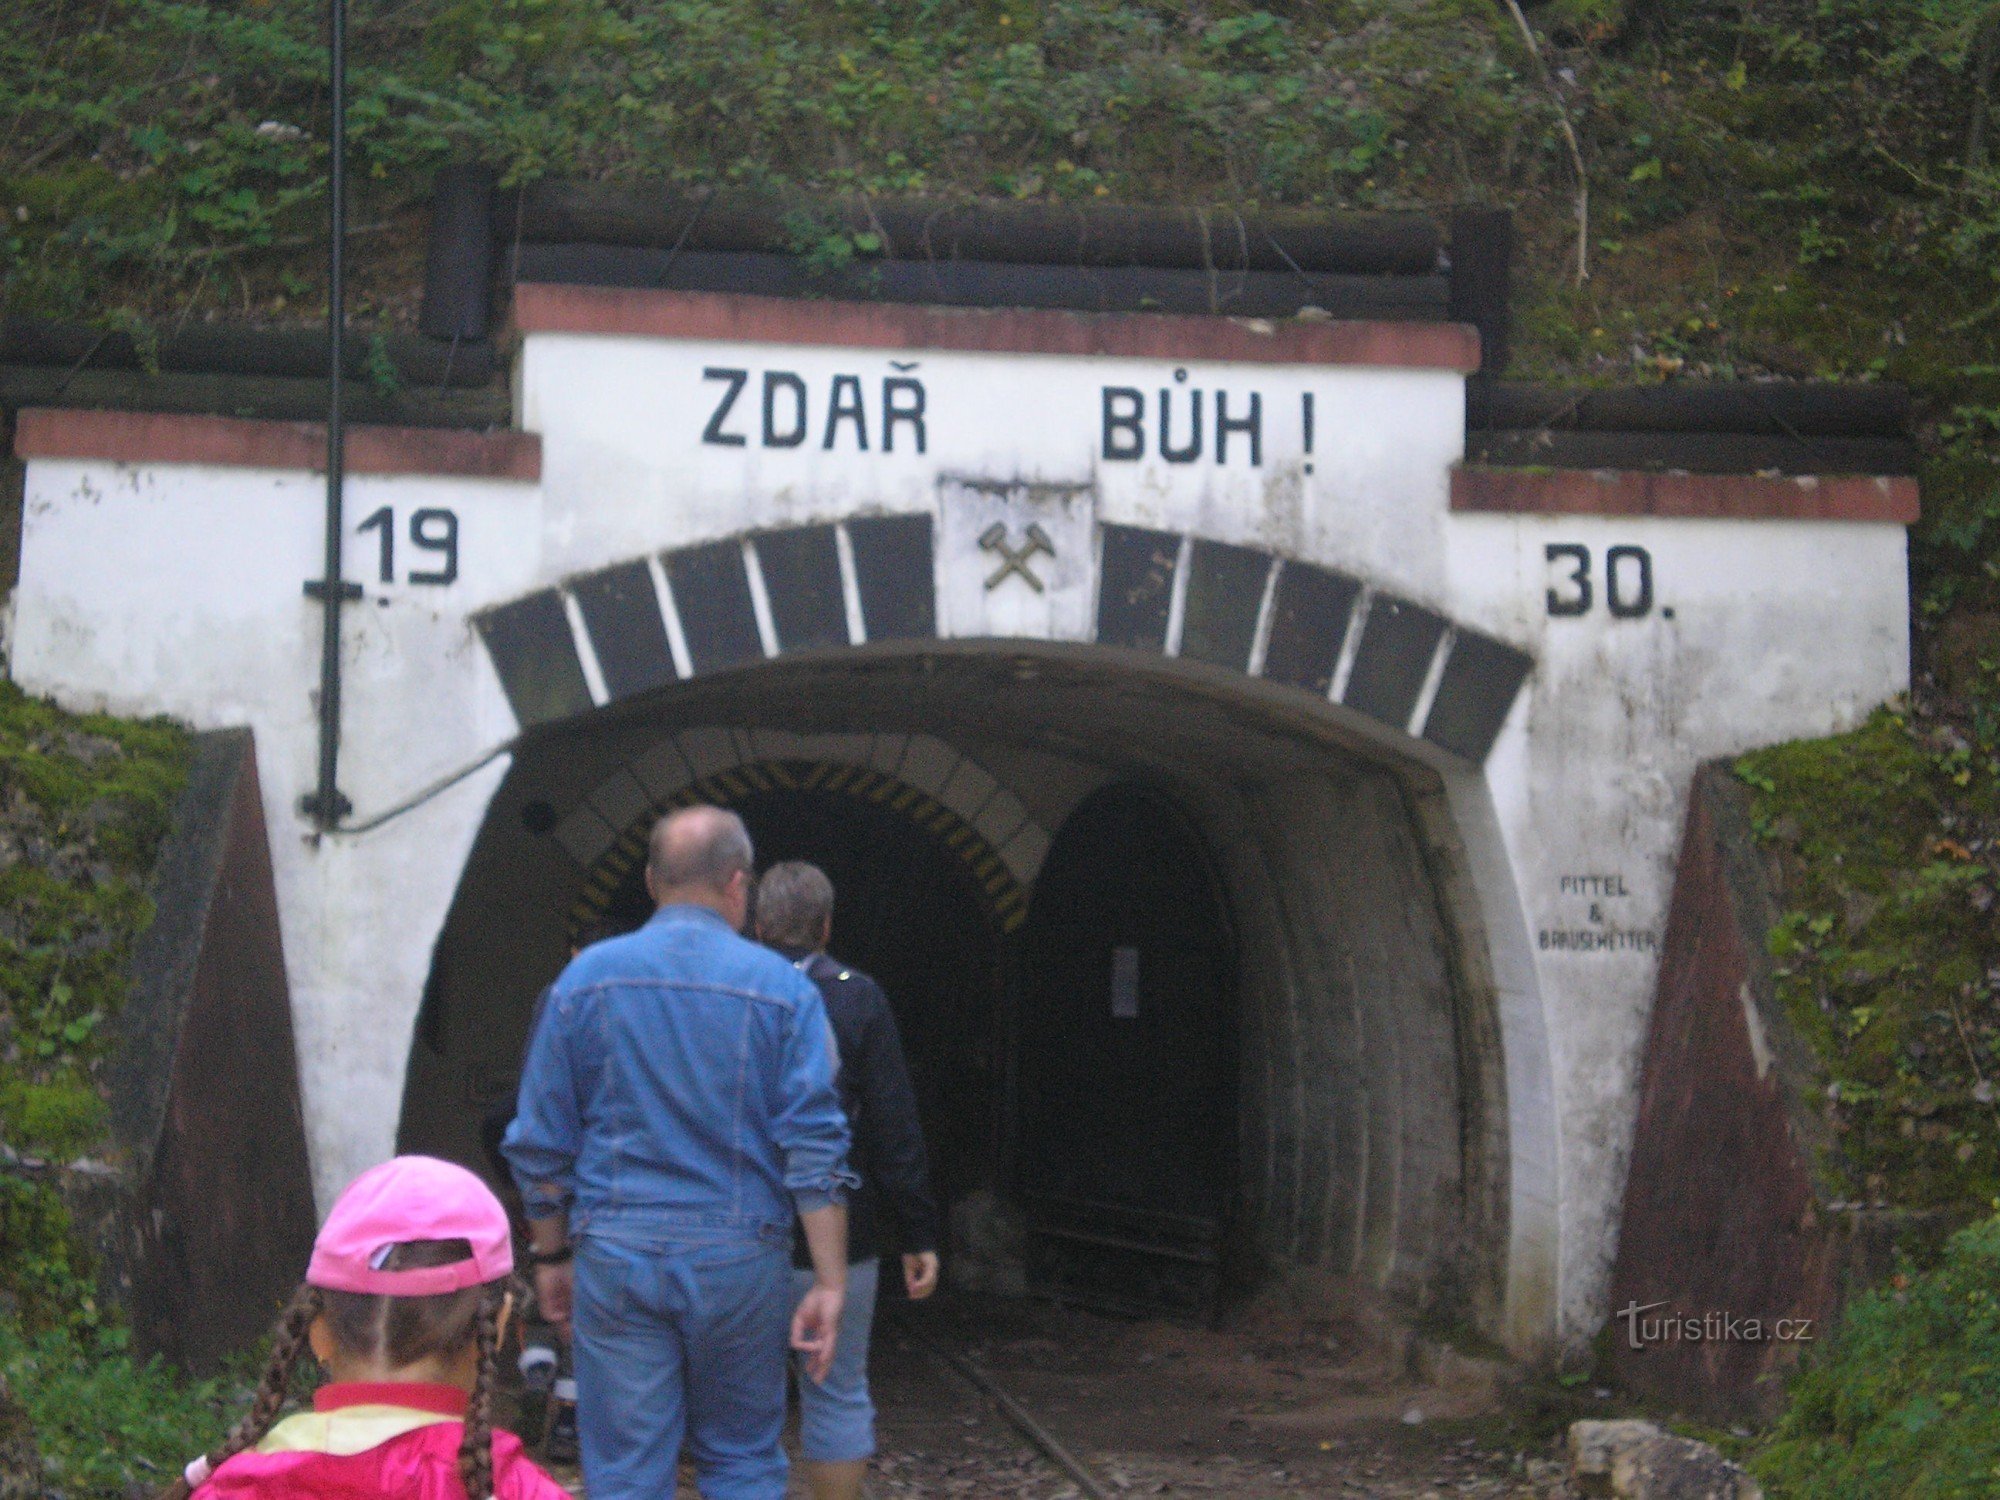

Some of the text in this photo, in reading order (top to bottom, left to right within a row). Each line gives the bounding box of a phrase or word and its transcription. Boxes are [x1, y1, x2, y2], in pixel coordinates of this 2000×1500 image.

[702, 361, 927, 454] ZDAŘ
[1101, 367, 1262, 467] BŮH
[356, 505, 459, 585] 19
